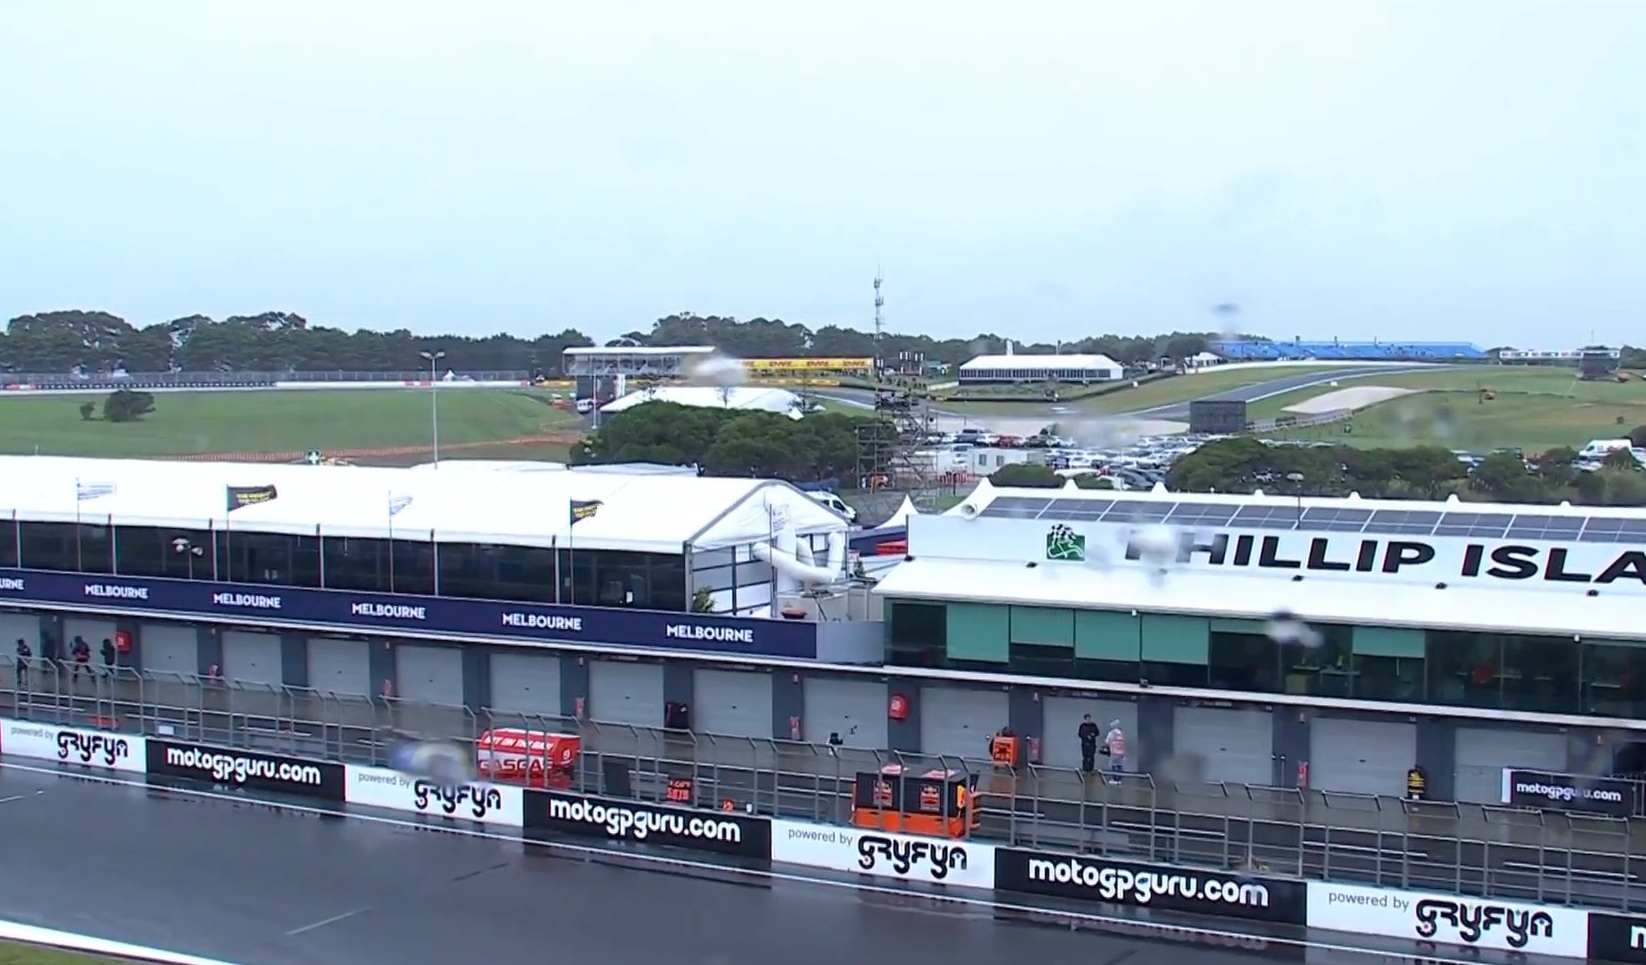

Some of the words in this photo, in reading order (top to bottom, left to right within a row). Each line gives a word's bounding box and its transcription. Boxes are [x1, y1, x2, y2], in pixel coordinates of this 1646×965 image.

[1125, 530, 1436, 573] HILLIP
[84, 585, 149, 599] MELBOURNE
[213, 592, 281, 608] MELBOURNE
[351, 603, 426, 619] MELBOURNE
[502, 613, 582, 630] MELBOURNE
[666, 624, 754, 642] MELBOURNE
[11, 726, 43, 738] powered
[167, 747, 321, 785] motogpguru.com
[358, 772, 397, 786] powered
[1516, 782, 1622, 801] motogpguu.com
[550, 798, 741, 843] motogpguru.com
[788, 828, 835, 843] powered
[839, 833, 853, 847] by
[1028, 859, 1269, 907] motogpguru.com
[1328, 891, 1388, 909] powered
[1393, 895, 1410, 912] by
